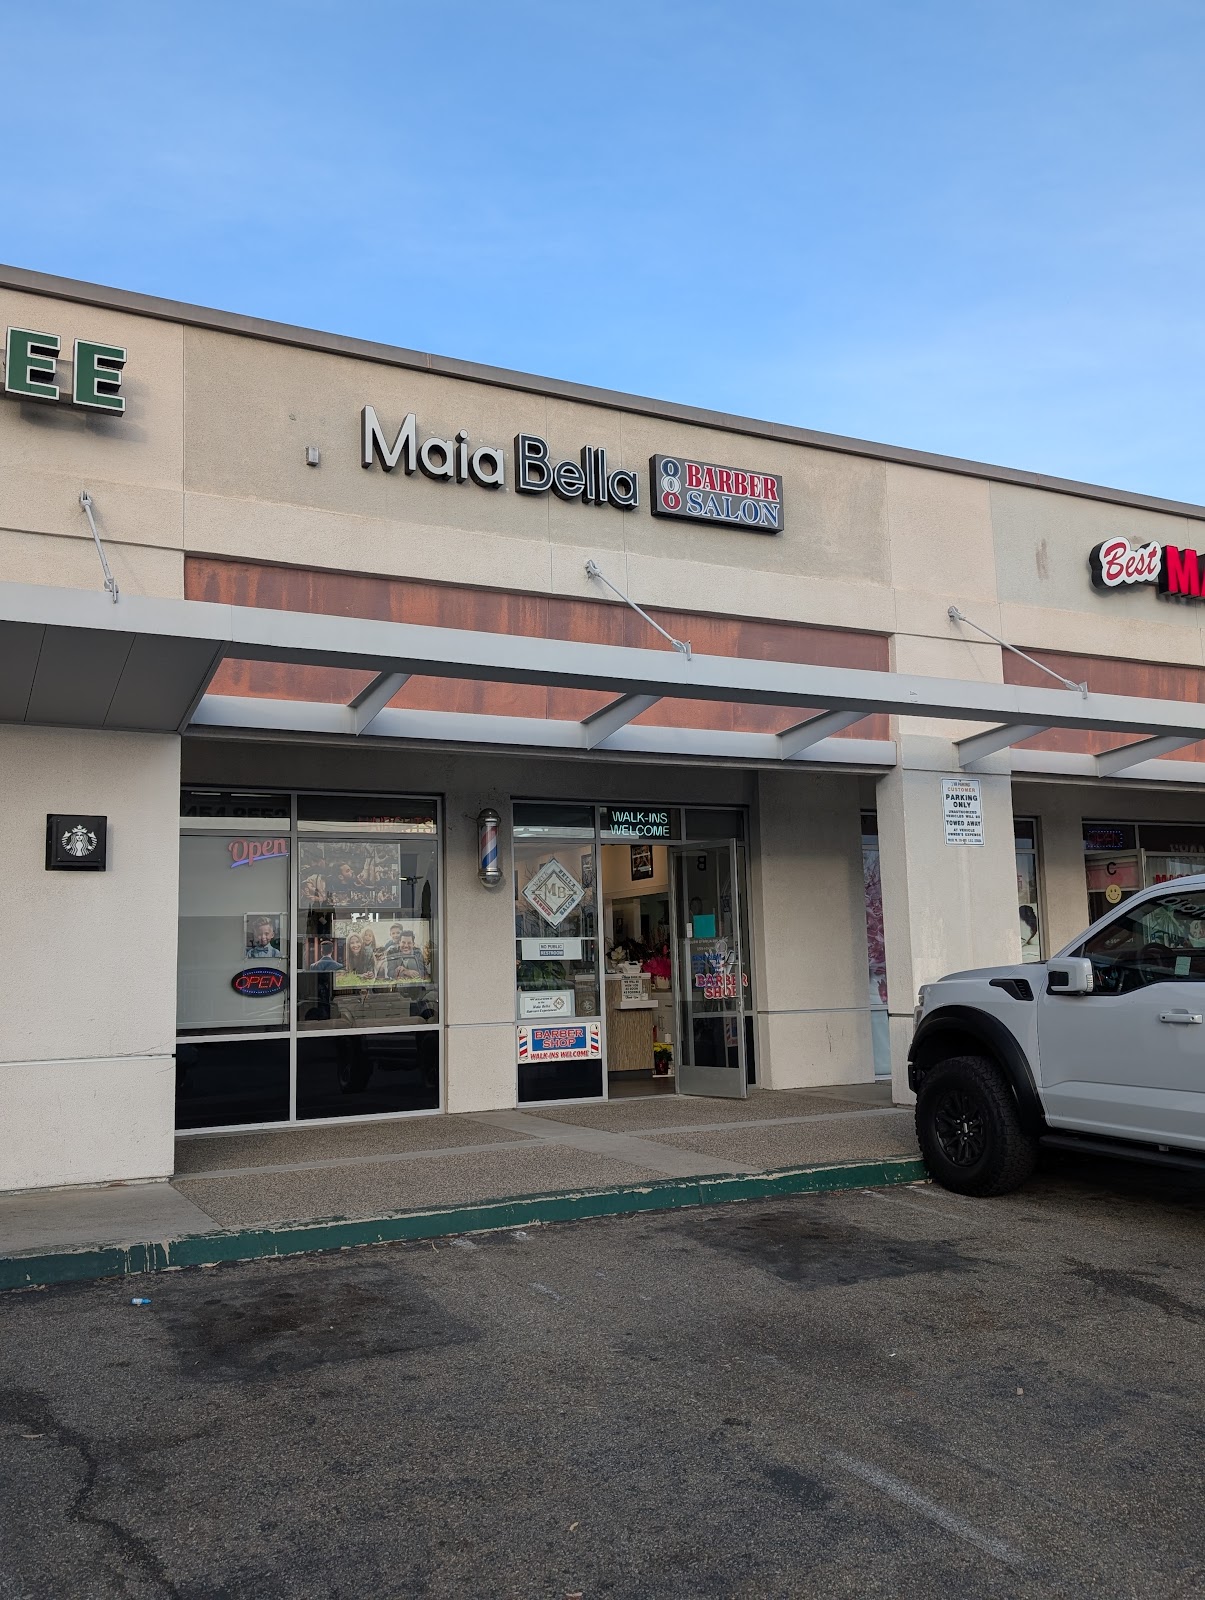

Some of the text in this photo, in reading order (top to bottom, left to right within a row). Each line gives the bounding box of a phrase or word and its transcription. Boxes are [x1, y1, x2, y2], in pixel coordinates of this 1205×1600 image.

[5, 326, 127, 415] EE
[361, 405, 639, 510] Maia Bella
[685, 462, 779, 502] BARBER
[686, 491, 779, 527] SALON
[1103, 542, 1158, 581] Best
[612, 811, 668, 824] WALK-INS
[610, 824, 670, 837] WELCOME
[228, 838, 287, 866] Open
[1107, 862, 1116, 875] C
[560, 898, 576, 916] SALON
[235, 976, 283, 989] OPEN
[535, 1029, 584, 1040] BARBER
[543, 1038, 576, 1048] SHOP
[530, 1050, 590, 1060] WALK-INS WELCOME
